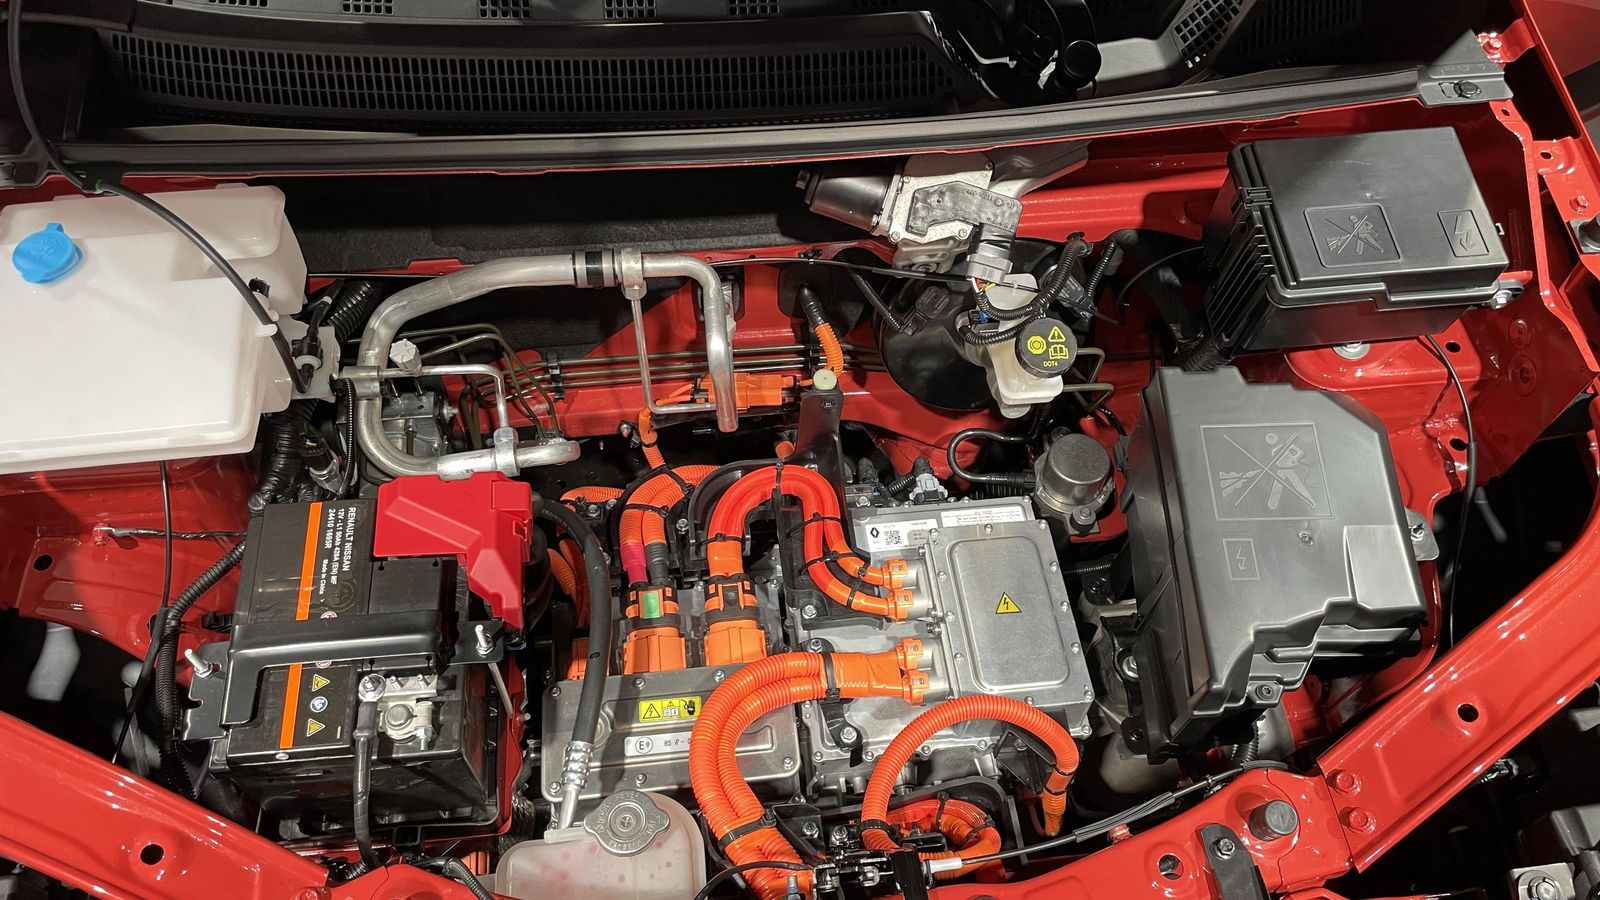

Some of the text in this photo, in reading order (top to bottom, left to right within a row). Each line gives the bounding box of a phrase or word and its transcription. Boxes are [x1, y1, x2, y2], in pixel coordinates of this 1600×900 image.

[327, 508, 336, 528] 24410
[337, 508, 345, 519] 12V
[334, 531, 343, 546] 50Ah
[342, 507, 356, 571] RENAULT NISSAN
[321, 559, 329, 573] Made
[330, 562, 339, 575] (EN)
[319, 579, 327, 595] China
[330, 575, 338, 585] MF
[675, 739, 680, 747] R
